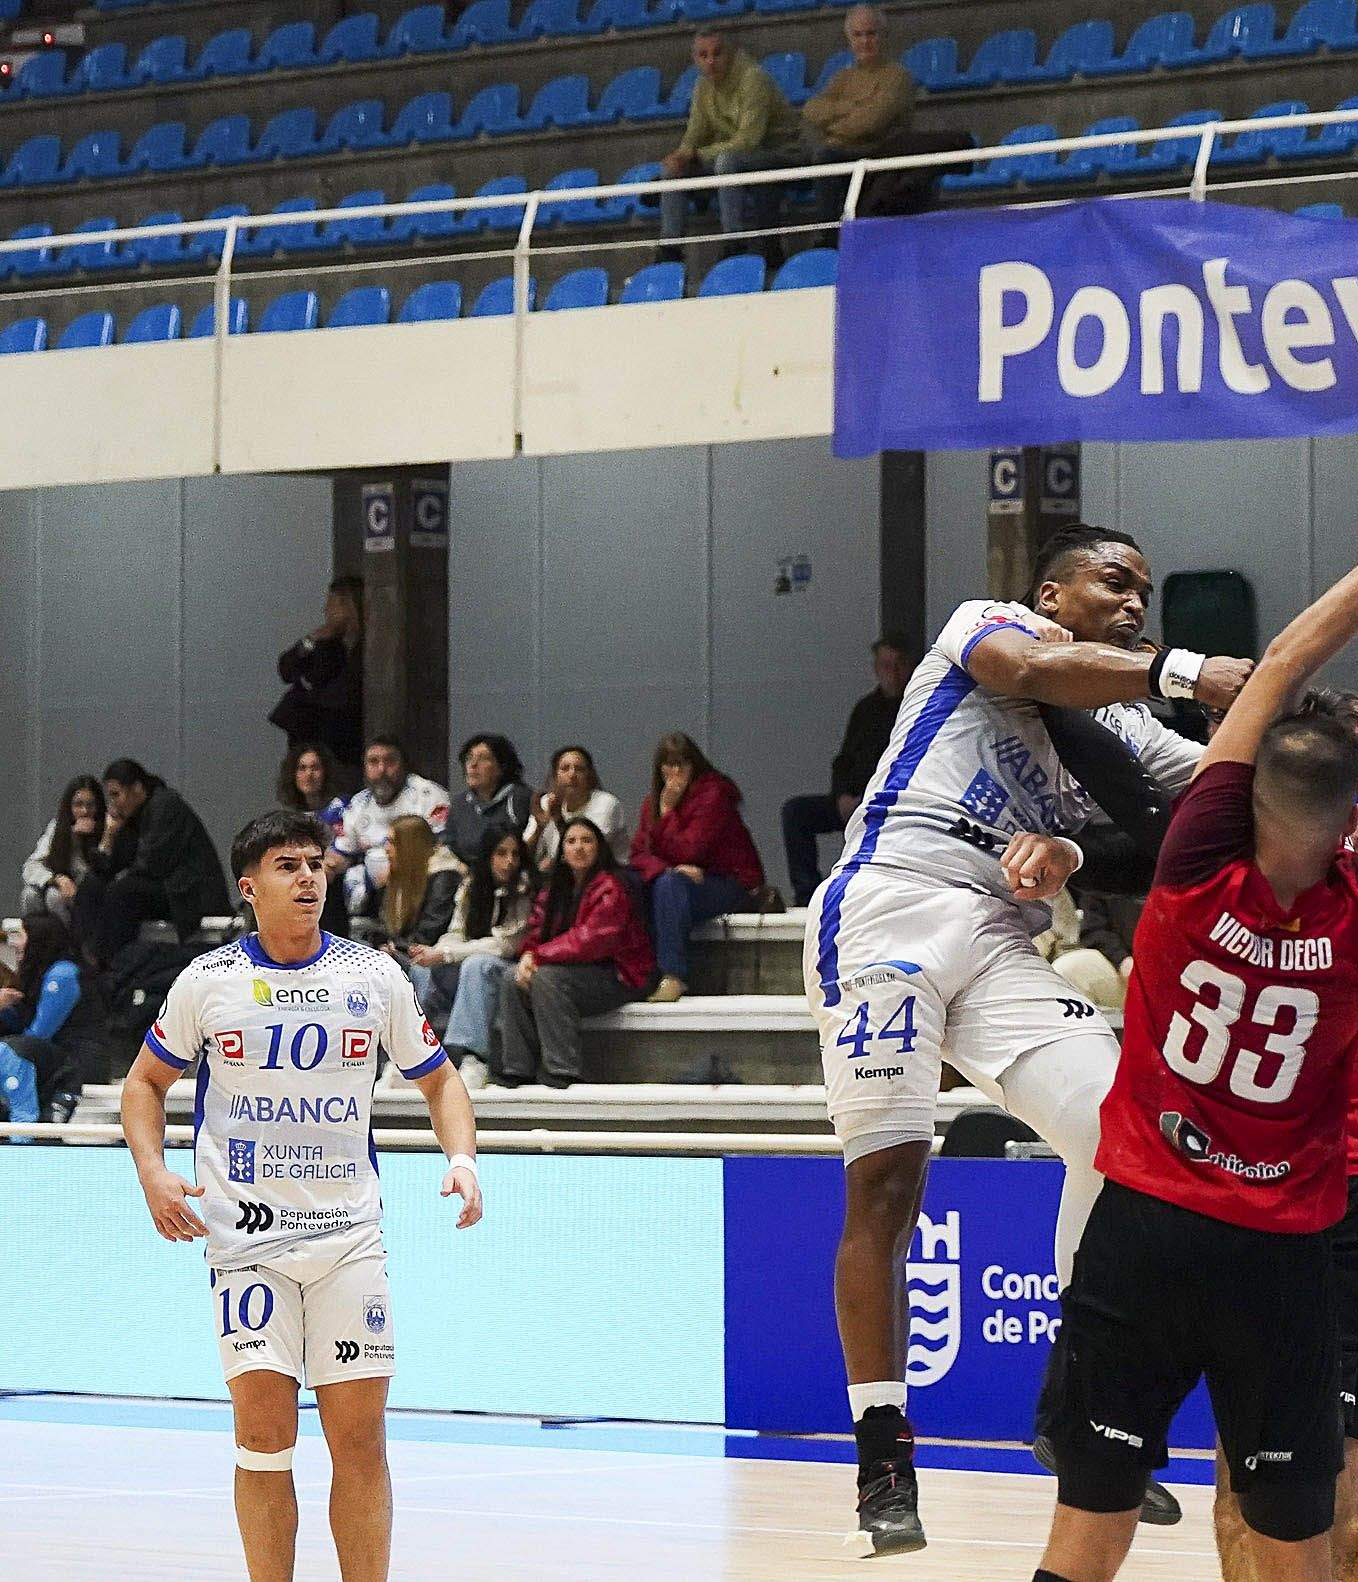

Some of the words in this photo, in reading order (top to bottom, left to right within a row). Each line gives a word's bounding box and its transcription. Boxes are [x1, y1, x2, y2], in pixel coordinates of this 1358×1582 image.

[994, 458, 1017, 493] C
[1047, 457, 1072, 493] C
[368, 499, 389, 533] C
[1208, 911, 1275, 969] VICTOR
[1280, 936, 1333, 971] DECO
[276, 988, 329, 1003] ence
[836, 995, 918, 1059] 44
[1162, 959, 1320, 1104] 33
[259, 1022, 328, 1070] 10
[854, 1066, 904, 1080] Kempa
[262, 1145, 323, 1160] XUNTA
[262, 1164, 285, 1178] DE
[289, 1162, 356, 1179] GALICIA
[280, 1207, 349, 1221] Deputación
[219, 1283, 274, 1338] 10
[982, 1309, 1023, 1344] de
[232, 1339, 267, 1352] Kempa
[1090, 1420, 1144, 1449] VIPS
